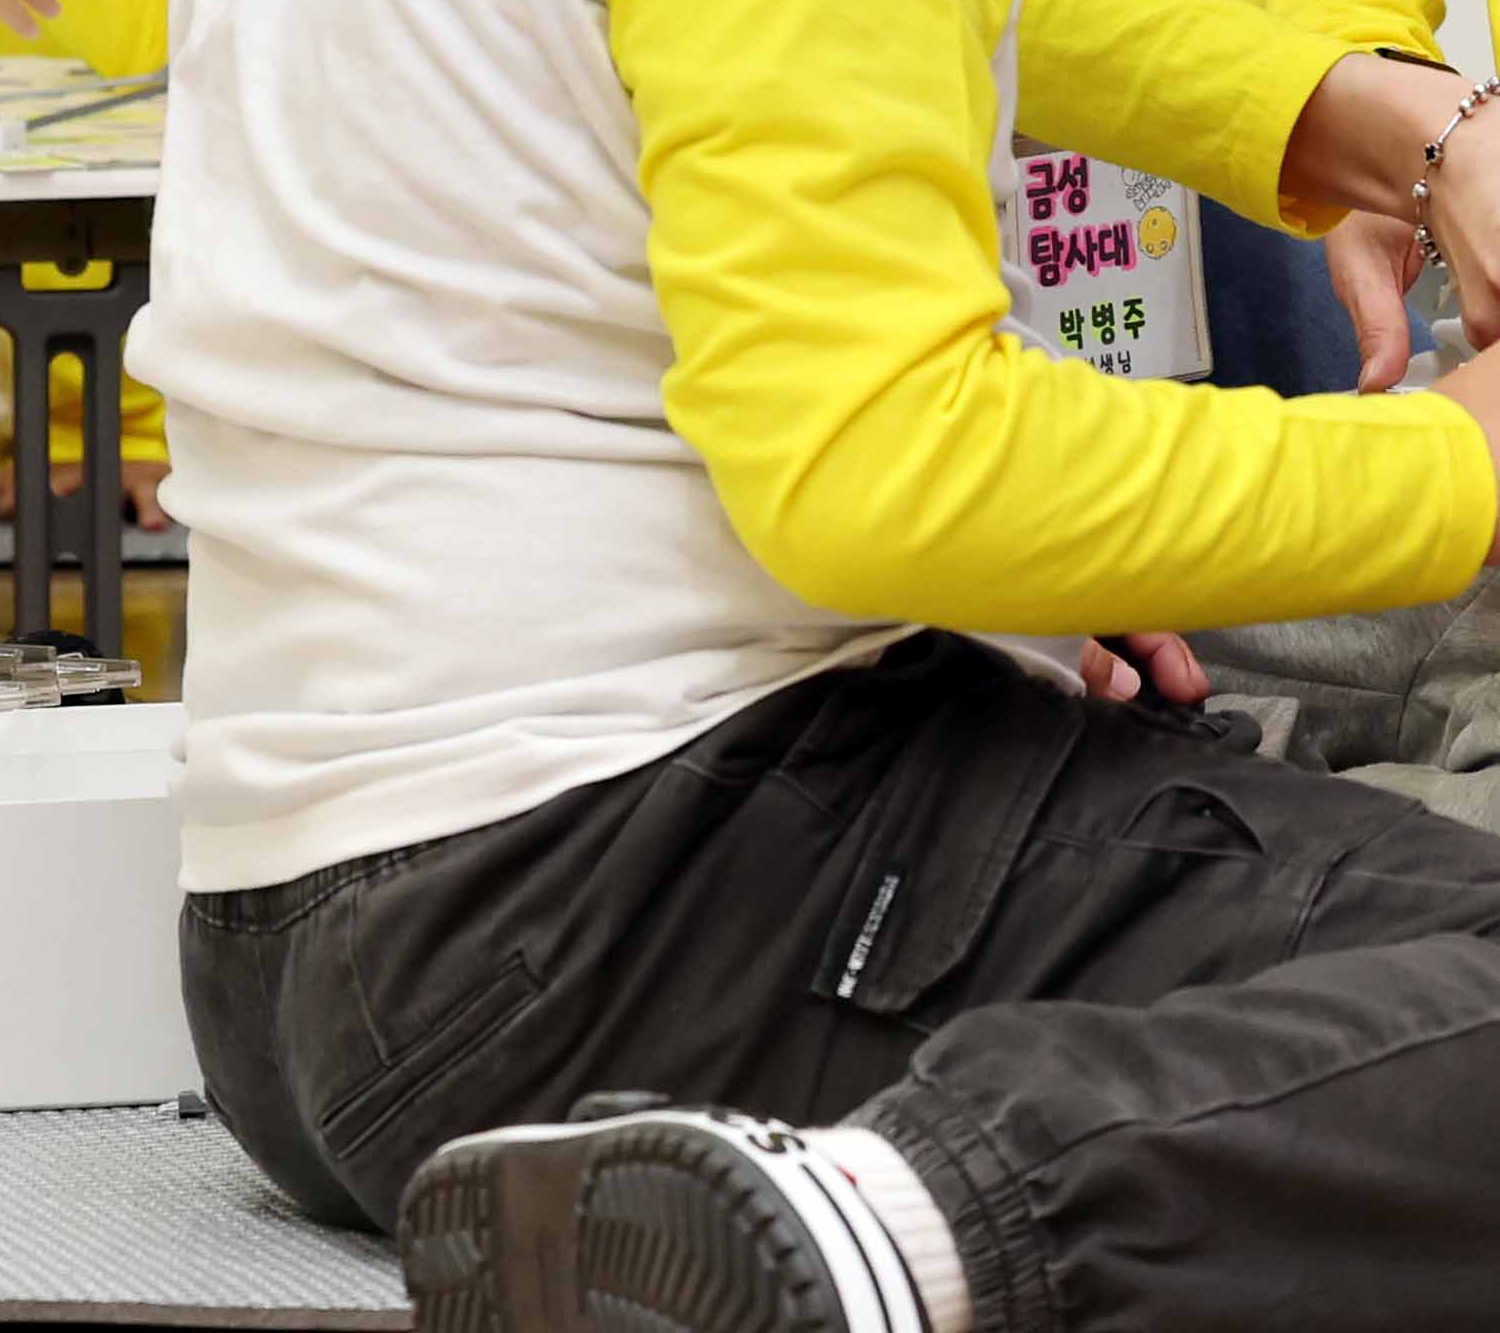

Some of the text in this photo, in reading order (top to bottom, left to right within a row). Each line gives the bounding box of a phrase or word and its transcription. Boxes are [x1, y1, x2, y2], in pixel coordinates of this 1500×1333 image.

[1027, 157, 1089, 221] 금성
[1031, 223, 1131, 287] 탐사대
[1059, 298, 1146, 350] 박병주
[1084, 350, 1132, 375] 생님
